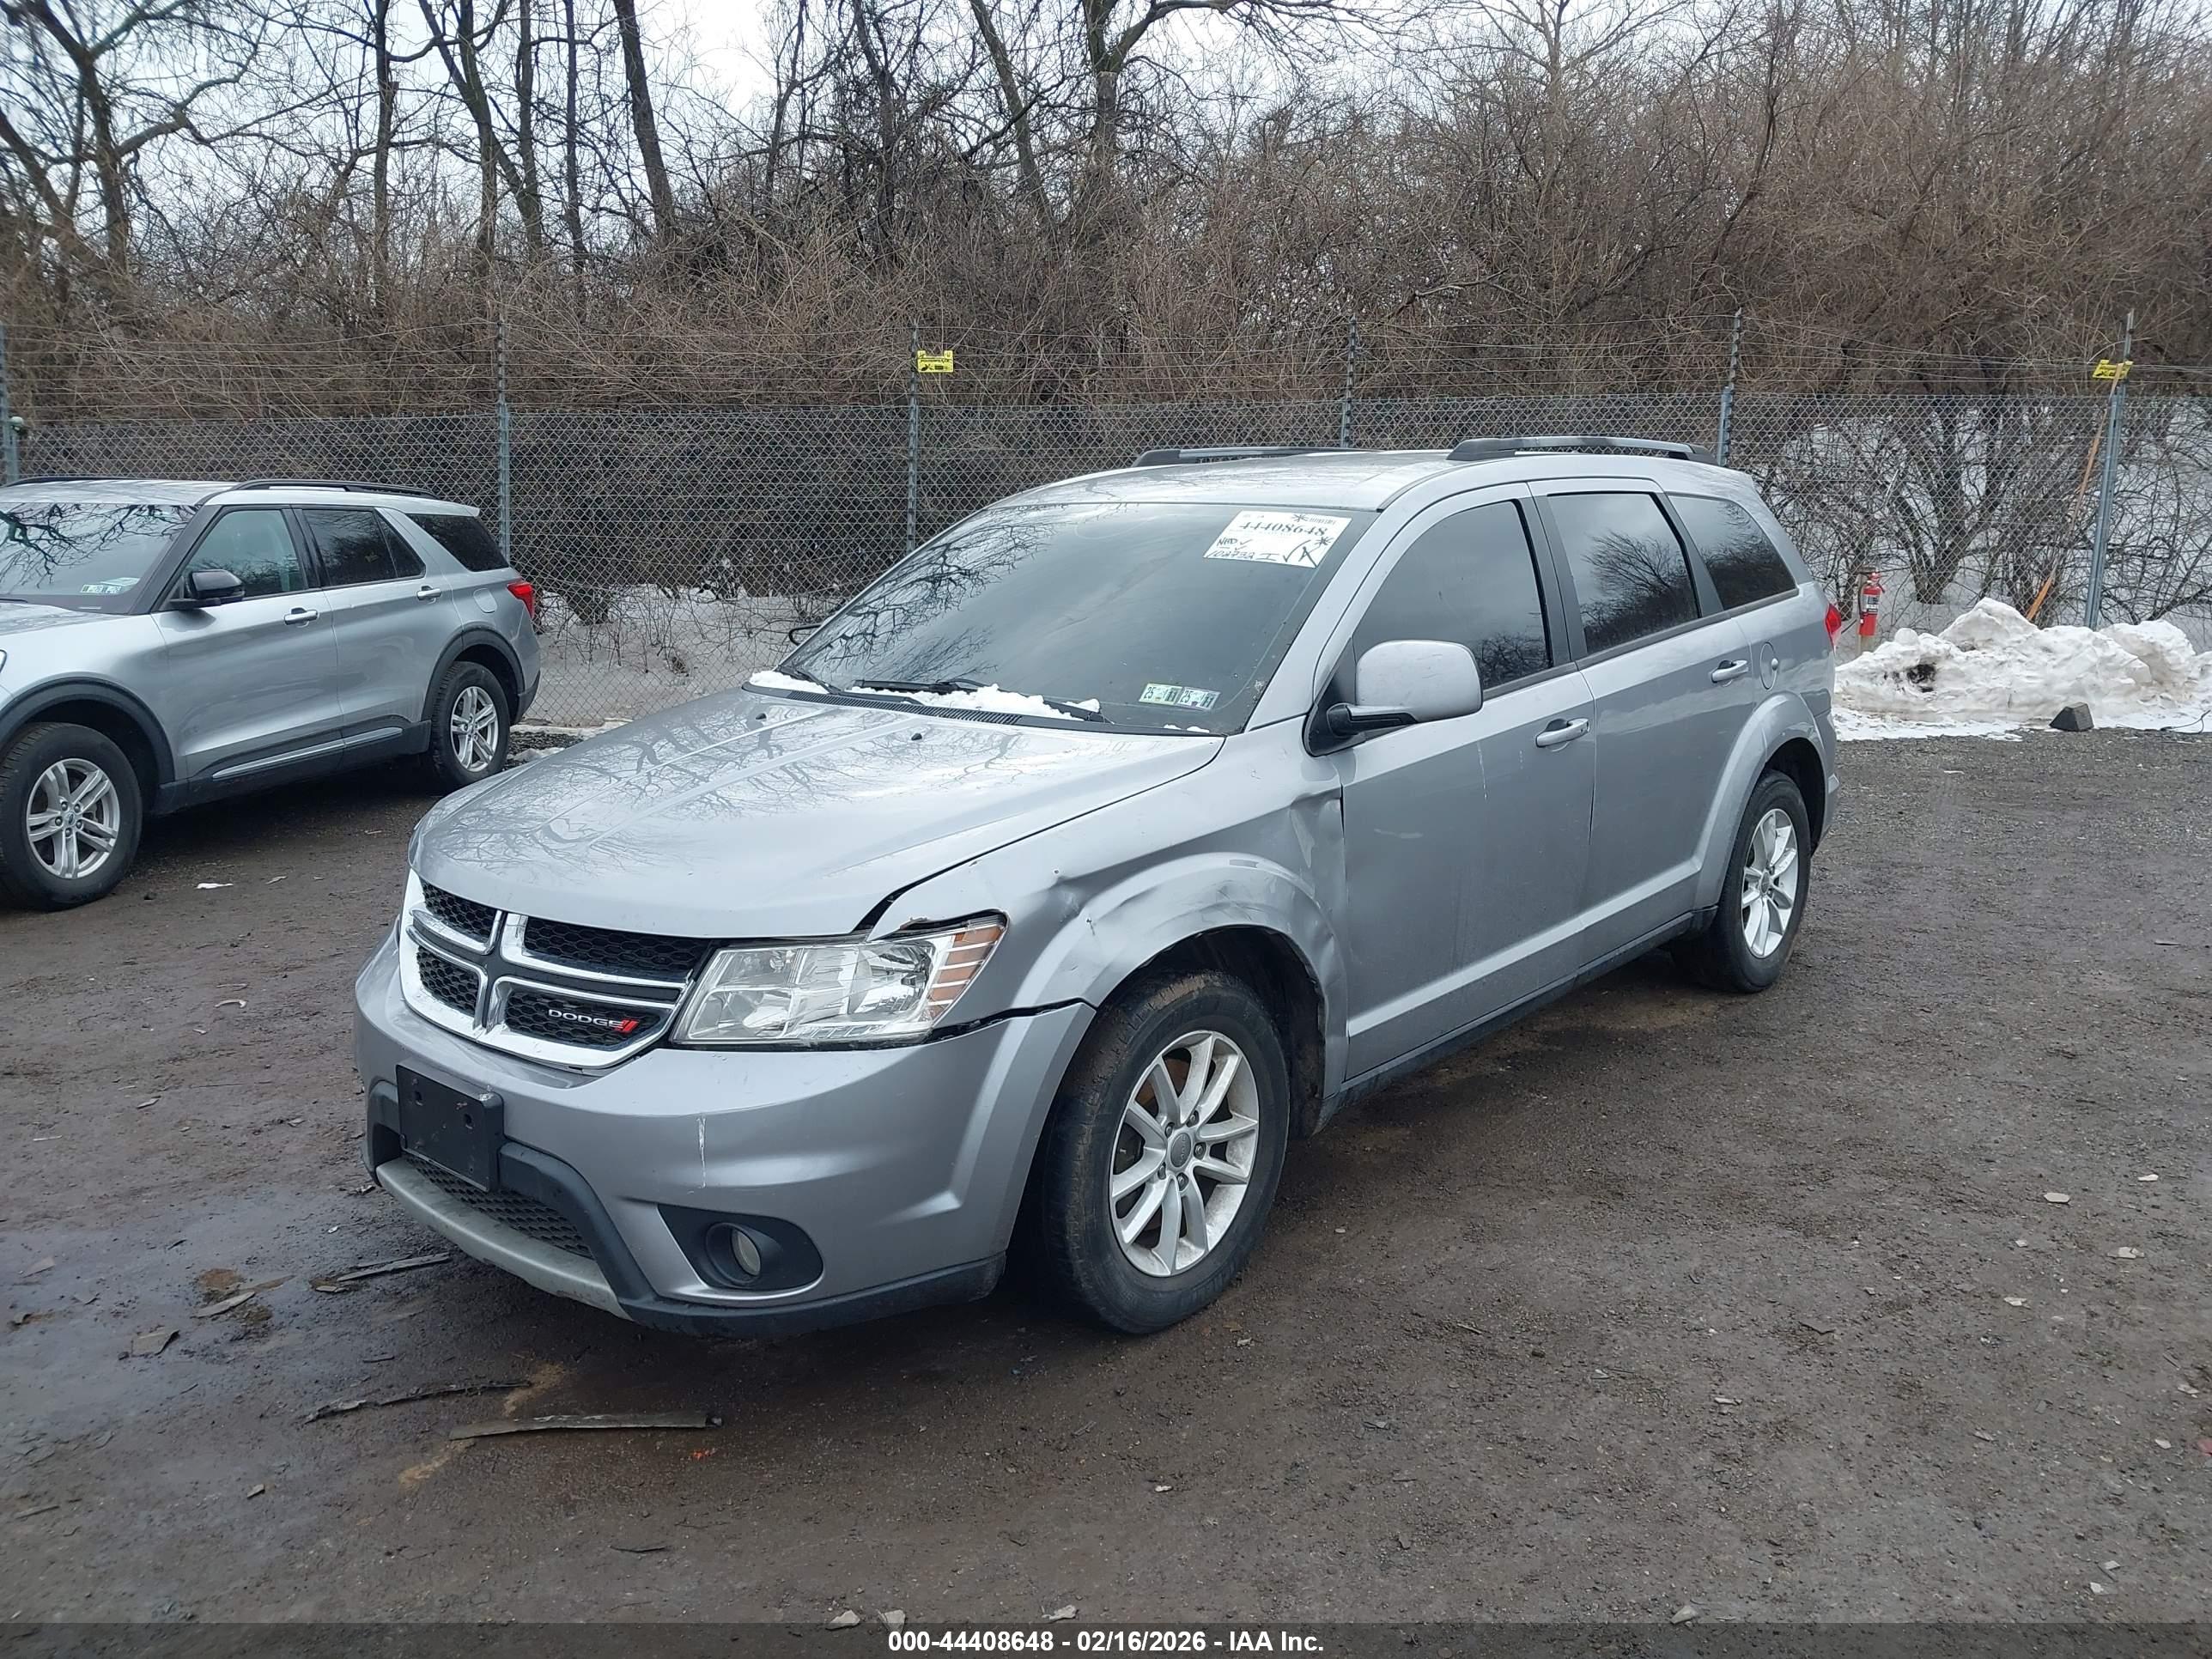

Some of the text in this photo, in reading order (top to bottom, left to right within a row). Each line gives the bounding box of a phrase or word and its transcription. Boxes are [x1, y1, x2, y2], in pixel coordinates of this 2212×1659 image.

[1239, 521, 1328, 537] 44408648
[1144, 686, 1156, 699] 25
[1180, 690, 1194, 703] 25
[549, 1009, 624, 1029] DODGE
